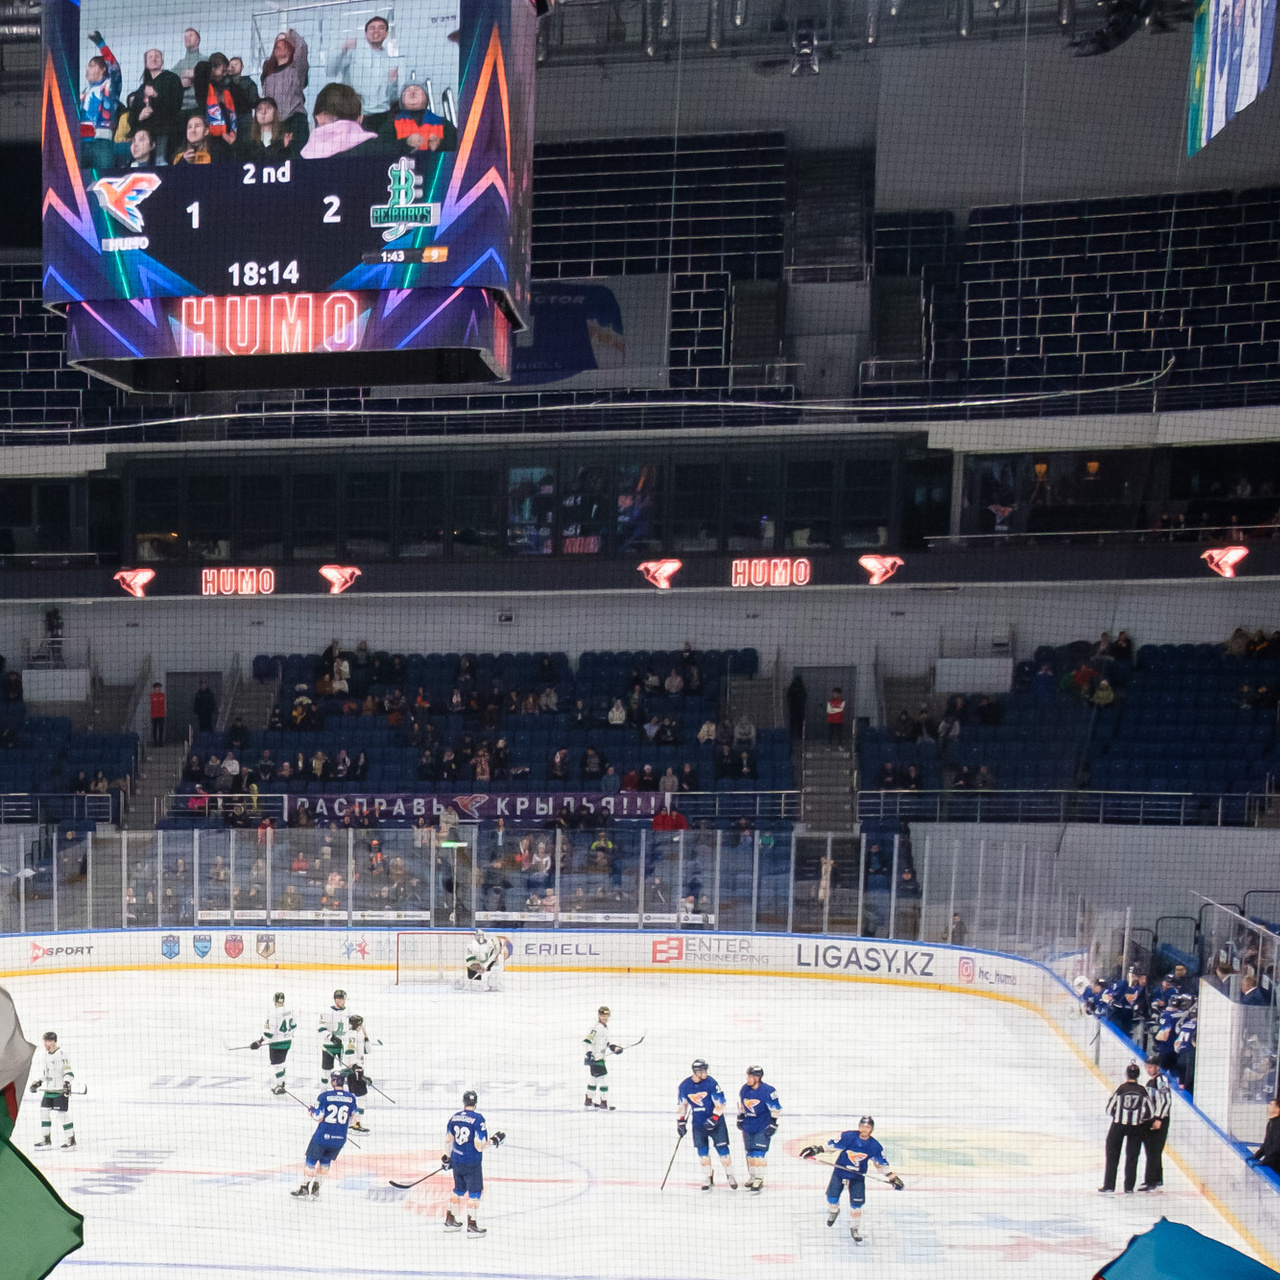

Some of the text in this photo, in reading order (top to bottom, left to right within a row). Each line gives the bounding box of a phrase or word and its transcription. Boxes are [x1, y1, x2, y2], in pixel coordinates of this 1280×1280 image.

[242, 160, 291, 184] 2 nd
[186, 201, 200, 229] 1
[323, 195, 341, 223] 2
[105, 236, 149, 252] HUMO
[381, 250, 405, 262] 1:43
[228, 260, 300, 286] 18:14
[181, 292, 358, 357] HUMO
[202, 568, 276, 595] HUMO
[731, 558, 811, 587] HUMO
[524, 942, 601, 956] ERIELL
[684, 937, 751, 954] ENTER
[684, 953, 769, 966] ENGINEERING
[796, 943, 935, 977] LIGASY.KZ
[978, 966, 1018, 986] hc_humo
[1123, 1094, 1140, 1109] 87
[325, 1104, 349, 1124] 26
